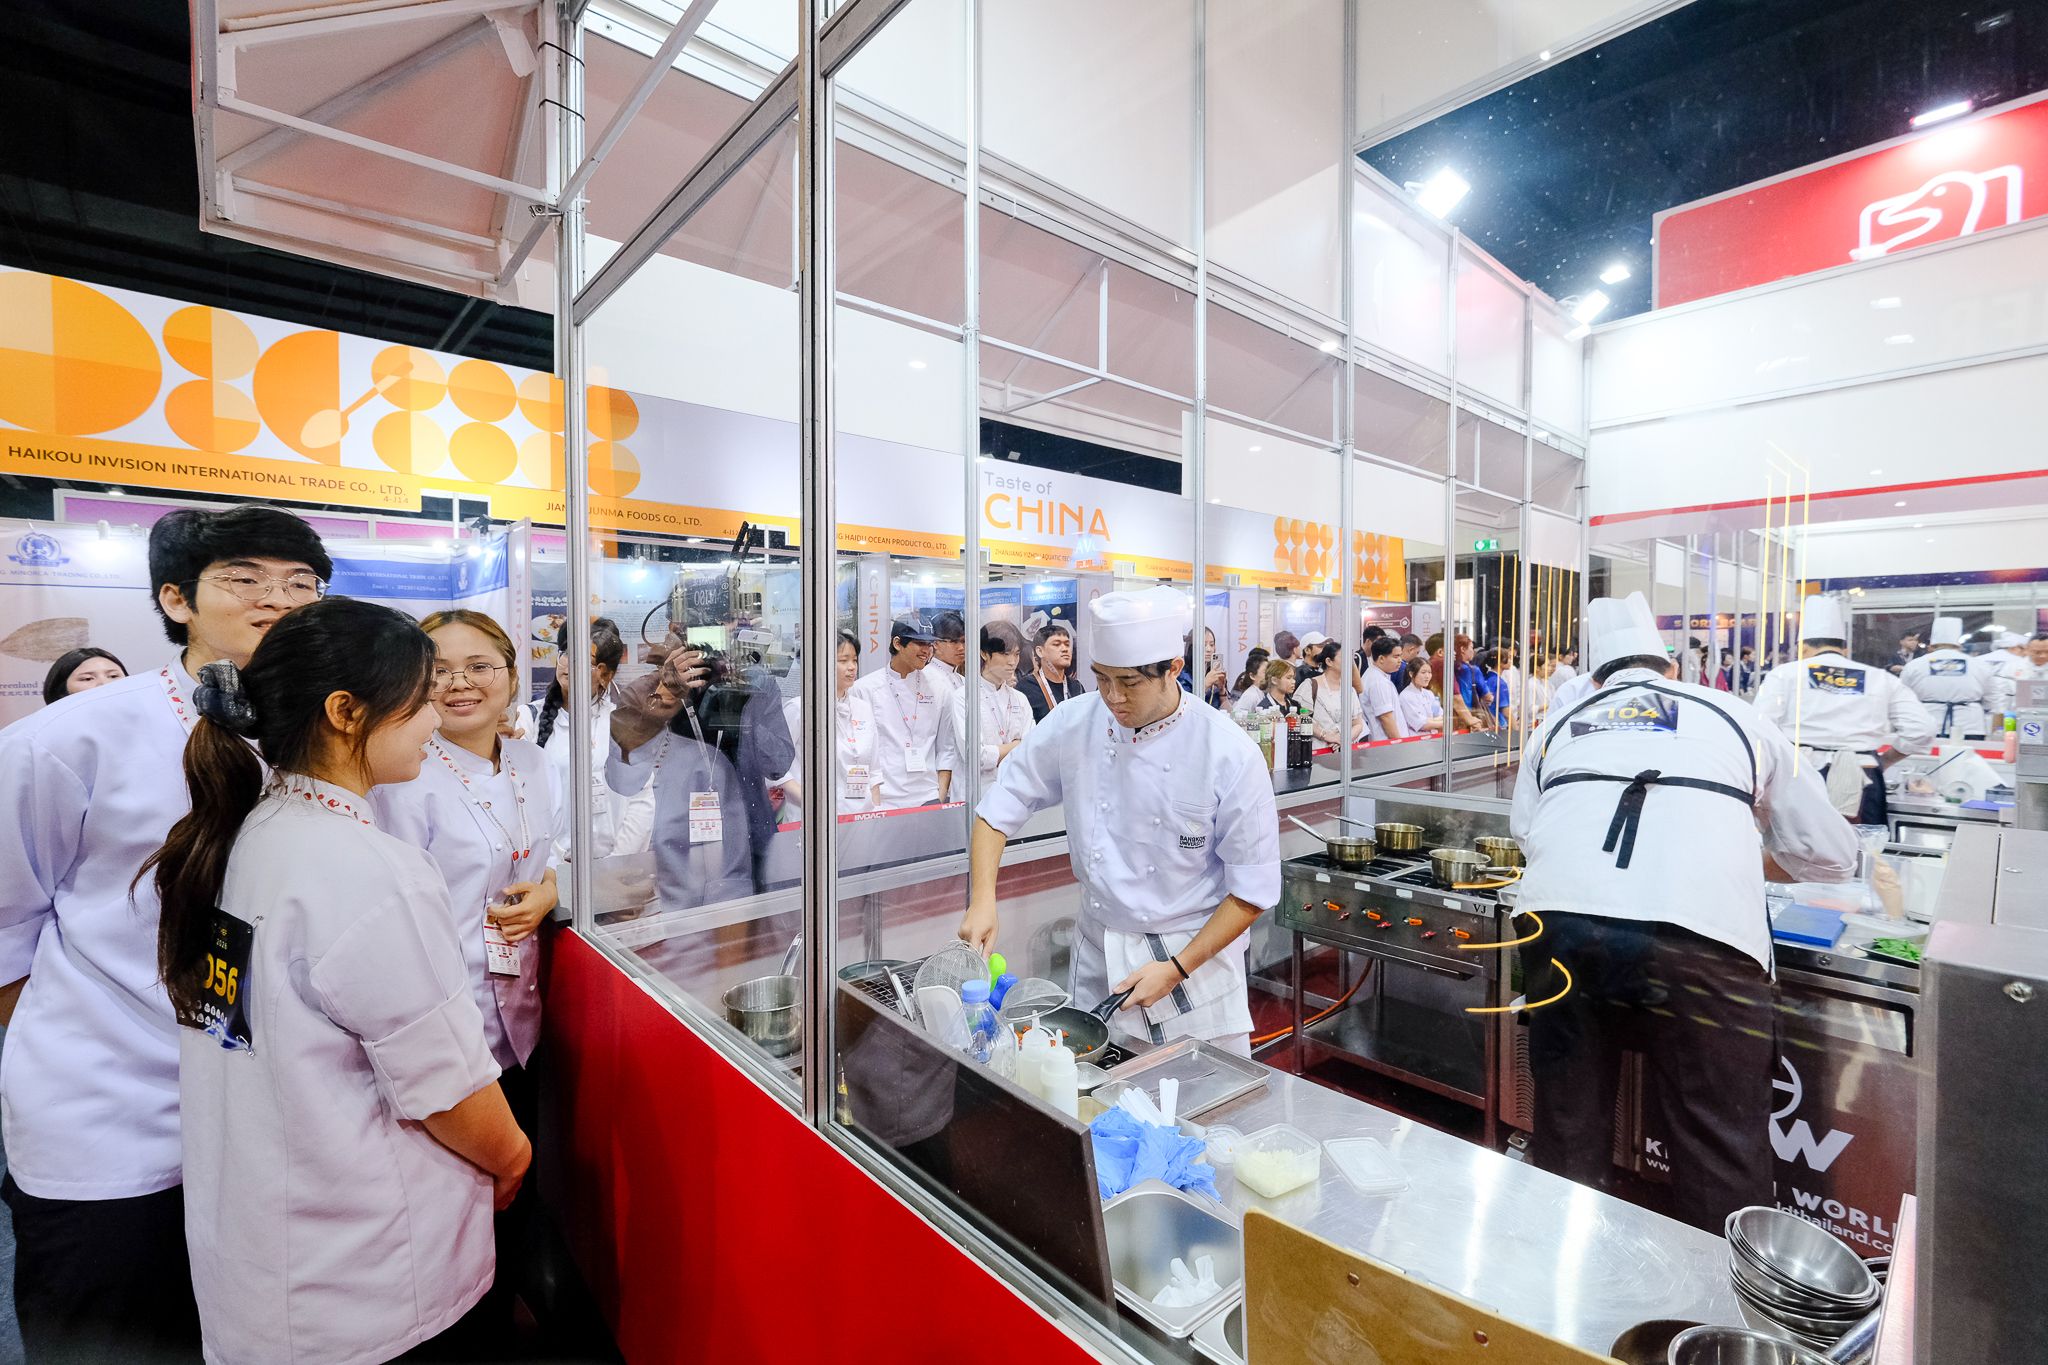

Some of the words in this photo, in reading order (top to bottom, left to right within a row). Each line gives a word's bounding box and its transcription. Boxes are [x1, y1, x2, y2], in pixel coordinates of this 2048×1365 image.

[8, 446, 82, 463] HAIKOU
[89, 455, 166, 472] INVISION
[172, 464, 296, 486] INTERNATIONAL
[300, 477, 345, 490] TRADE
[350, 482, 375, 494] CO.,
[380, 485, 406, 496] LTD.
[984, 471, 1031, 491] Taste
[1036, 481, 1052, 494] of
[546, 502, 566, 512] JIAN
[588, 508, 624, 518] JUNMA
[627, 511, 661, 522] FOODS
[663, 515, 682, 525] CO.,
[684, 517, 702, 527] LTD.
[984, 493, 1111, 542] CHINA
[869, 536, 891, 544] OCEAN
[892, 538, 921, 547] PRODUCT
[870, 576, 879, 653] CHINA
[1238, 599, 1248, 653] CHINA
[0, 681, 38, 689] reenland
[1812, 671, 1858, 687] T462
[854, 811, 887, 821] IMPACT
[941, 801, 966, 809] IMPAC
[1473, 904, 1488, 914] VJ
[1791, 1187, 1897, 1239] WORL
